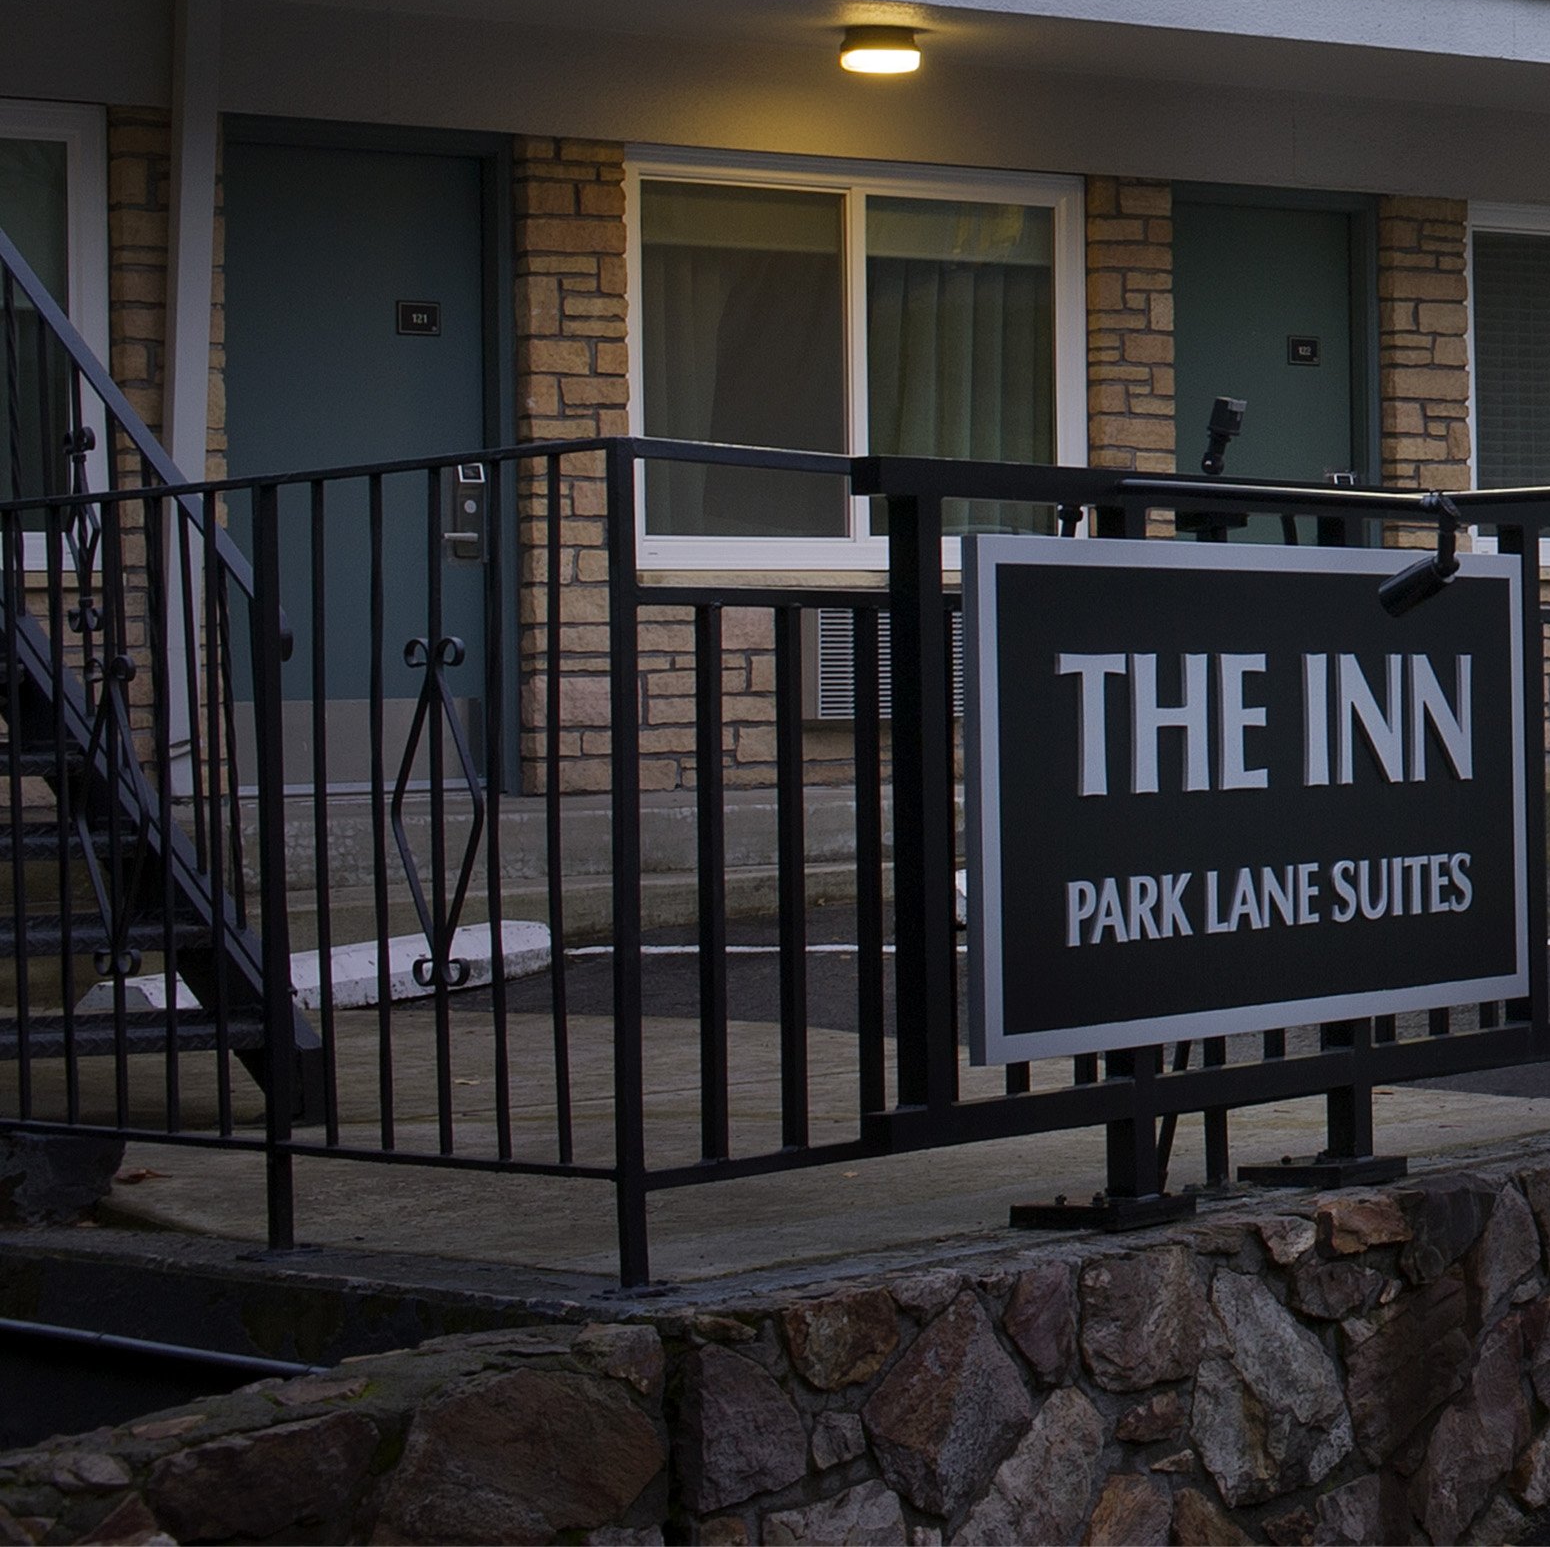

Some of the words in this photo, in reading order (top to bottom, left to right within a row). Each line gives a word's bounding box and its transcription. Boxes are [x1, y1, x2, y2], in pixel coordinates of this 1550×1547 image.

[412, 313, 428, 324] 121
[1054, 652, 1269, 797] THE
[1301, 652, 1474, 786] INN
[1065, 871, 1194, 948] PARK
[1203, 861, 1320, 935] LANE
[1331, 851, 1473, 924] SUITES
